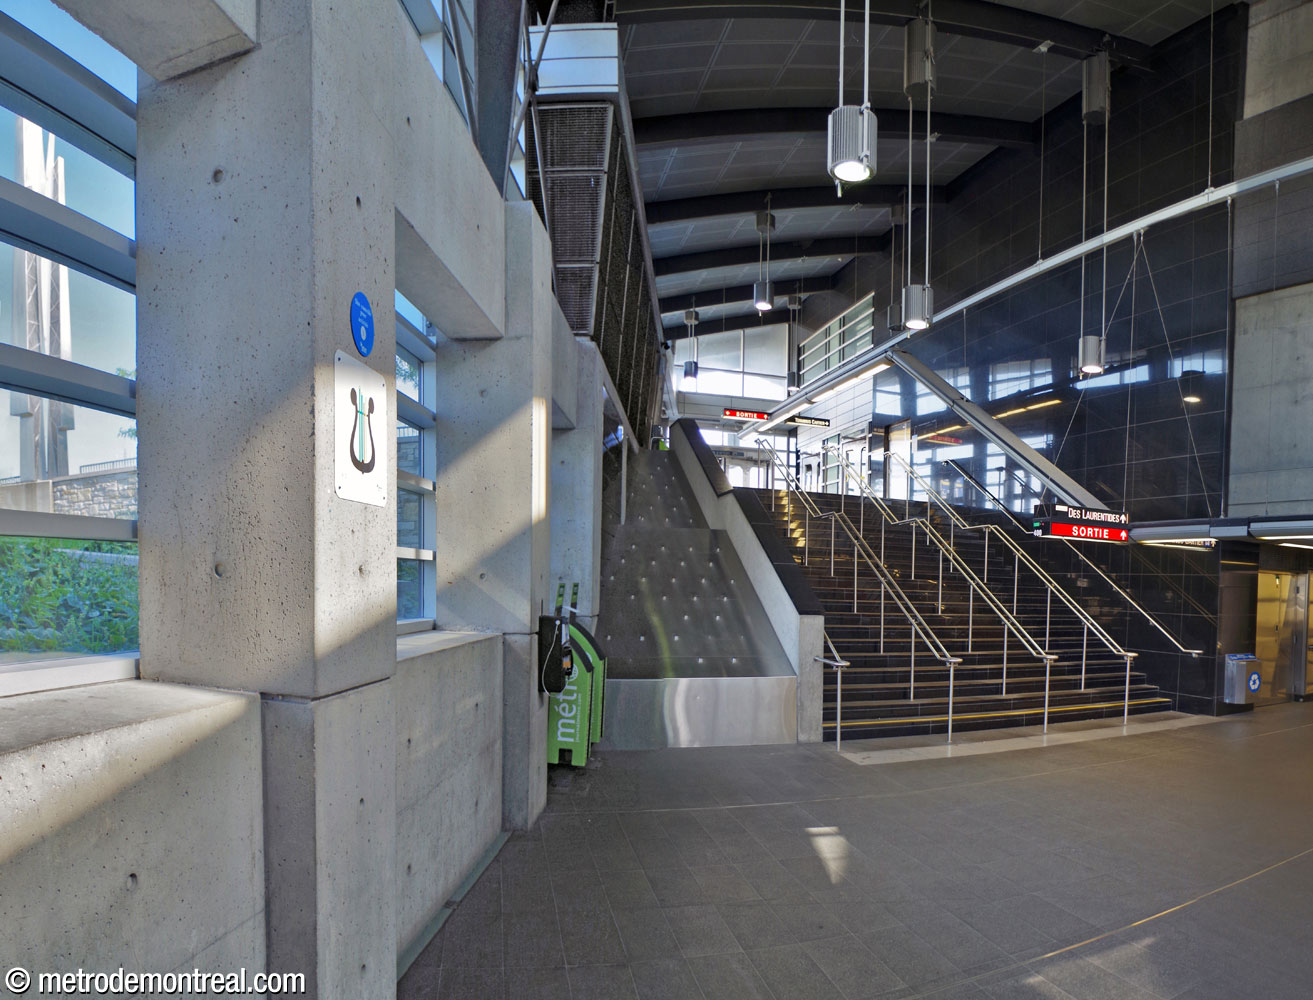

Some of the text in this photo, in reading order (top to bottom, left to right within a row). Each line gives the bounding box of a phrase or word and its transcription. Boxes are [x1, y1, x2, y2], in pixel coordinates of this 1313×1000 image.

[1068, 507, 1120, 523] DES LAURENTIDES
[1072, 526, 1109, 539] SORTIE
